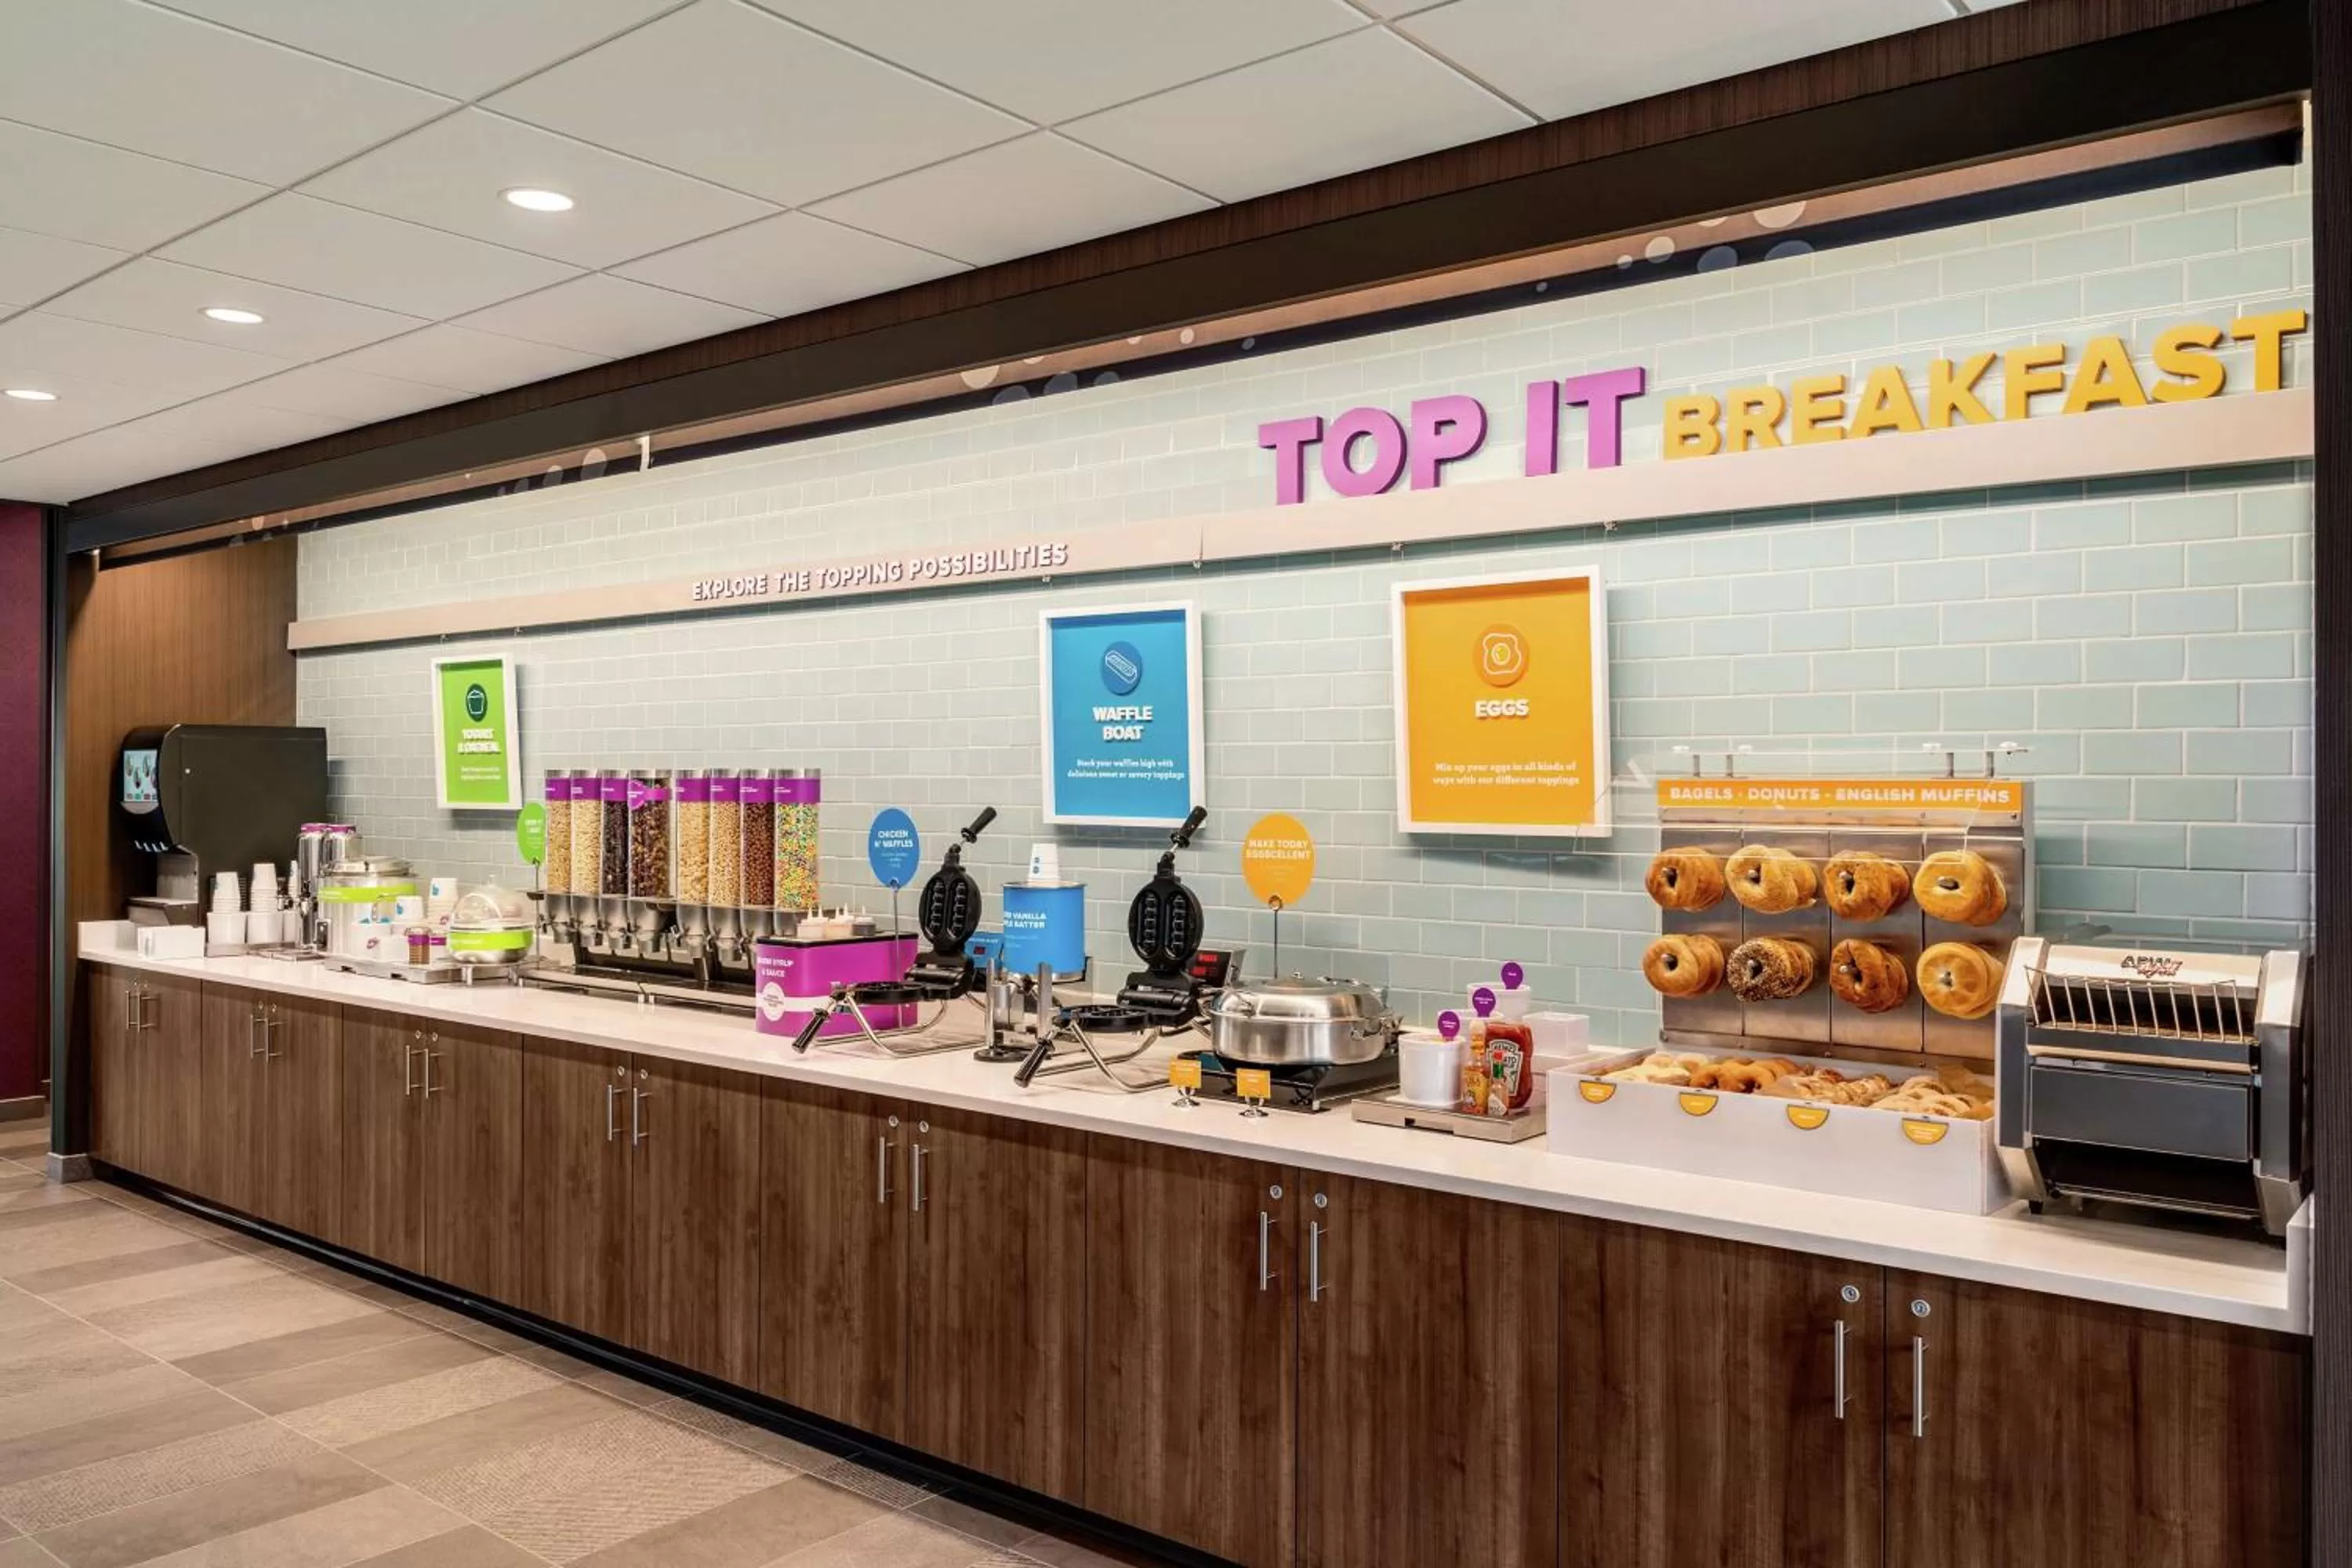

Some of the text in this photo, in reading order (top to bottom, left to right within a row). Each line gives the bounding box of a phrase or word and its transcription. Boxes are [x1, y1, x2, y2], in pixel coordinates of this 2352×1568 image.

[1258, 310, 2307, 506] TOP IT BREAKFAST
[692, 543, 1069, 601] EXPLORE THE TOPPING POSSIBILITIES
[1092, 706, 1153, 722] WAFFLE
[1475, 699, 1530, 718] EGGS
[1103, 725, 1144, 742] BOAT
[1157, 759, 1174, 768] with
[1566, 762, 1577, 771] of
[1457, 775, 1476, 785] with
[1670, 787, 2010, 804] BAGELS DONUTS ENGLISH MUFFINS
[1249, 840, 1308, 848] MAKE TODAY
[1246, 849, 1312, 860] EGGSCELLENT
[1014, 920, 1045, 929] BATTER
